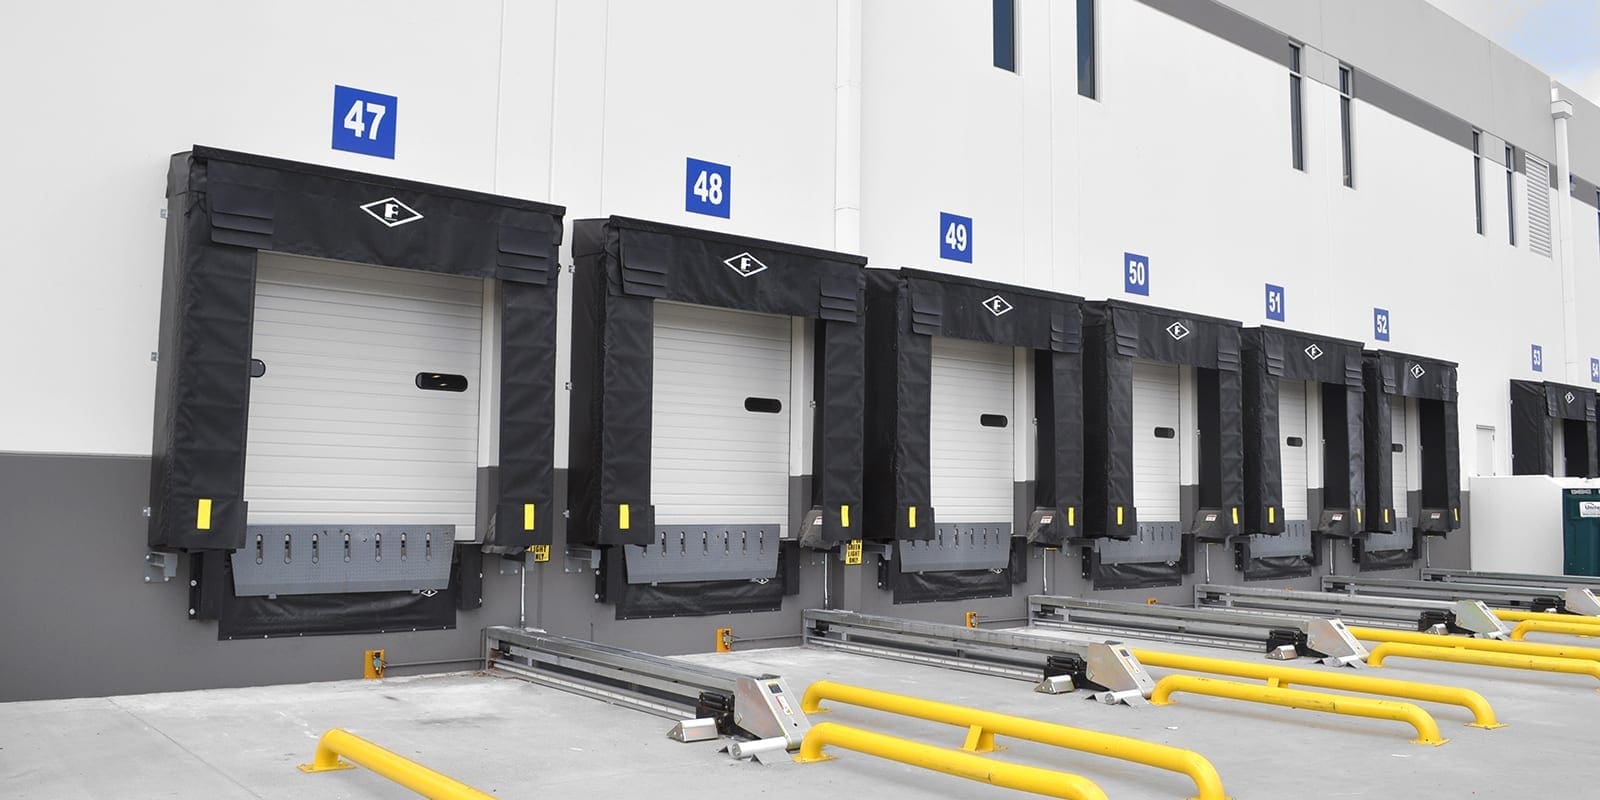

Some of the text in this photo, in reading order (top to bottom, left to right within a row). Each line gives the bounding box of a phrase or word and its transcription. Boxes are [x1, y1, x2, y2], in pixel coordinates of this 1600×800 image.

[343, 101, 386, 139] 47
[693, 171, 723, 204] 48
[945, 222, 967, 251] 49
[1128, 261, 1146, 287] 50
[1269, 291, 1281, 313] 51
[1376, 314, 1388, 334] 52
[1533, 349, 1541, 366] 53
[1592, 362, 1599, 378] 54
